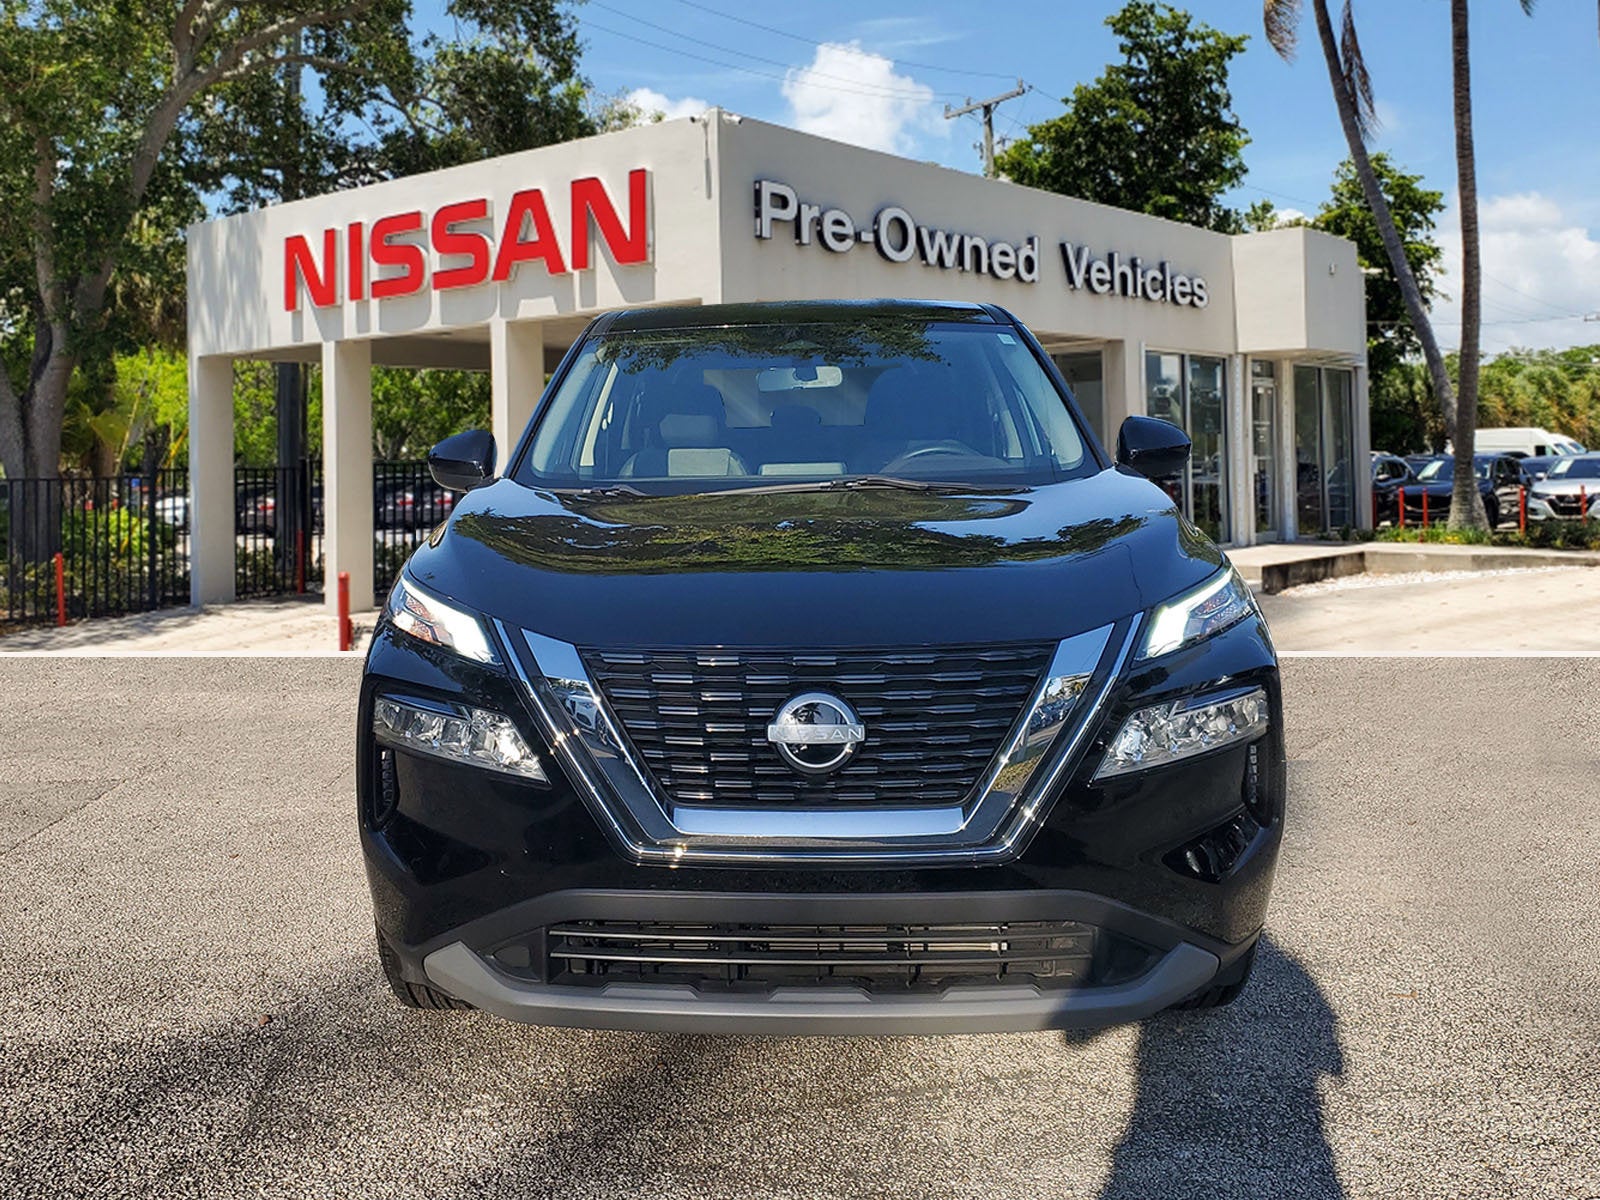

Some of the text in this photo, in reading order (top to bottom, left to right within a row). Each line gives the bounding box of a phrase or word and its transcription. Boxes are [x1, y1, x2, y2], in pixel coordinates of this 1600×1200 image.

[284, 168, 648, 312] NISSAN
[755, 180, 1209, 309] Pre-Owned Vehicles
[771, 727, 863, 741] SSAN
